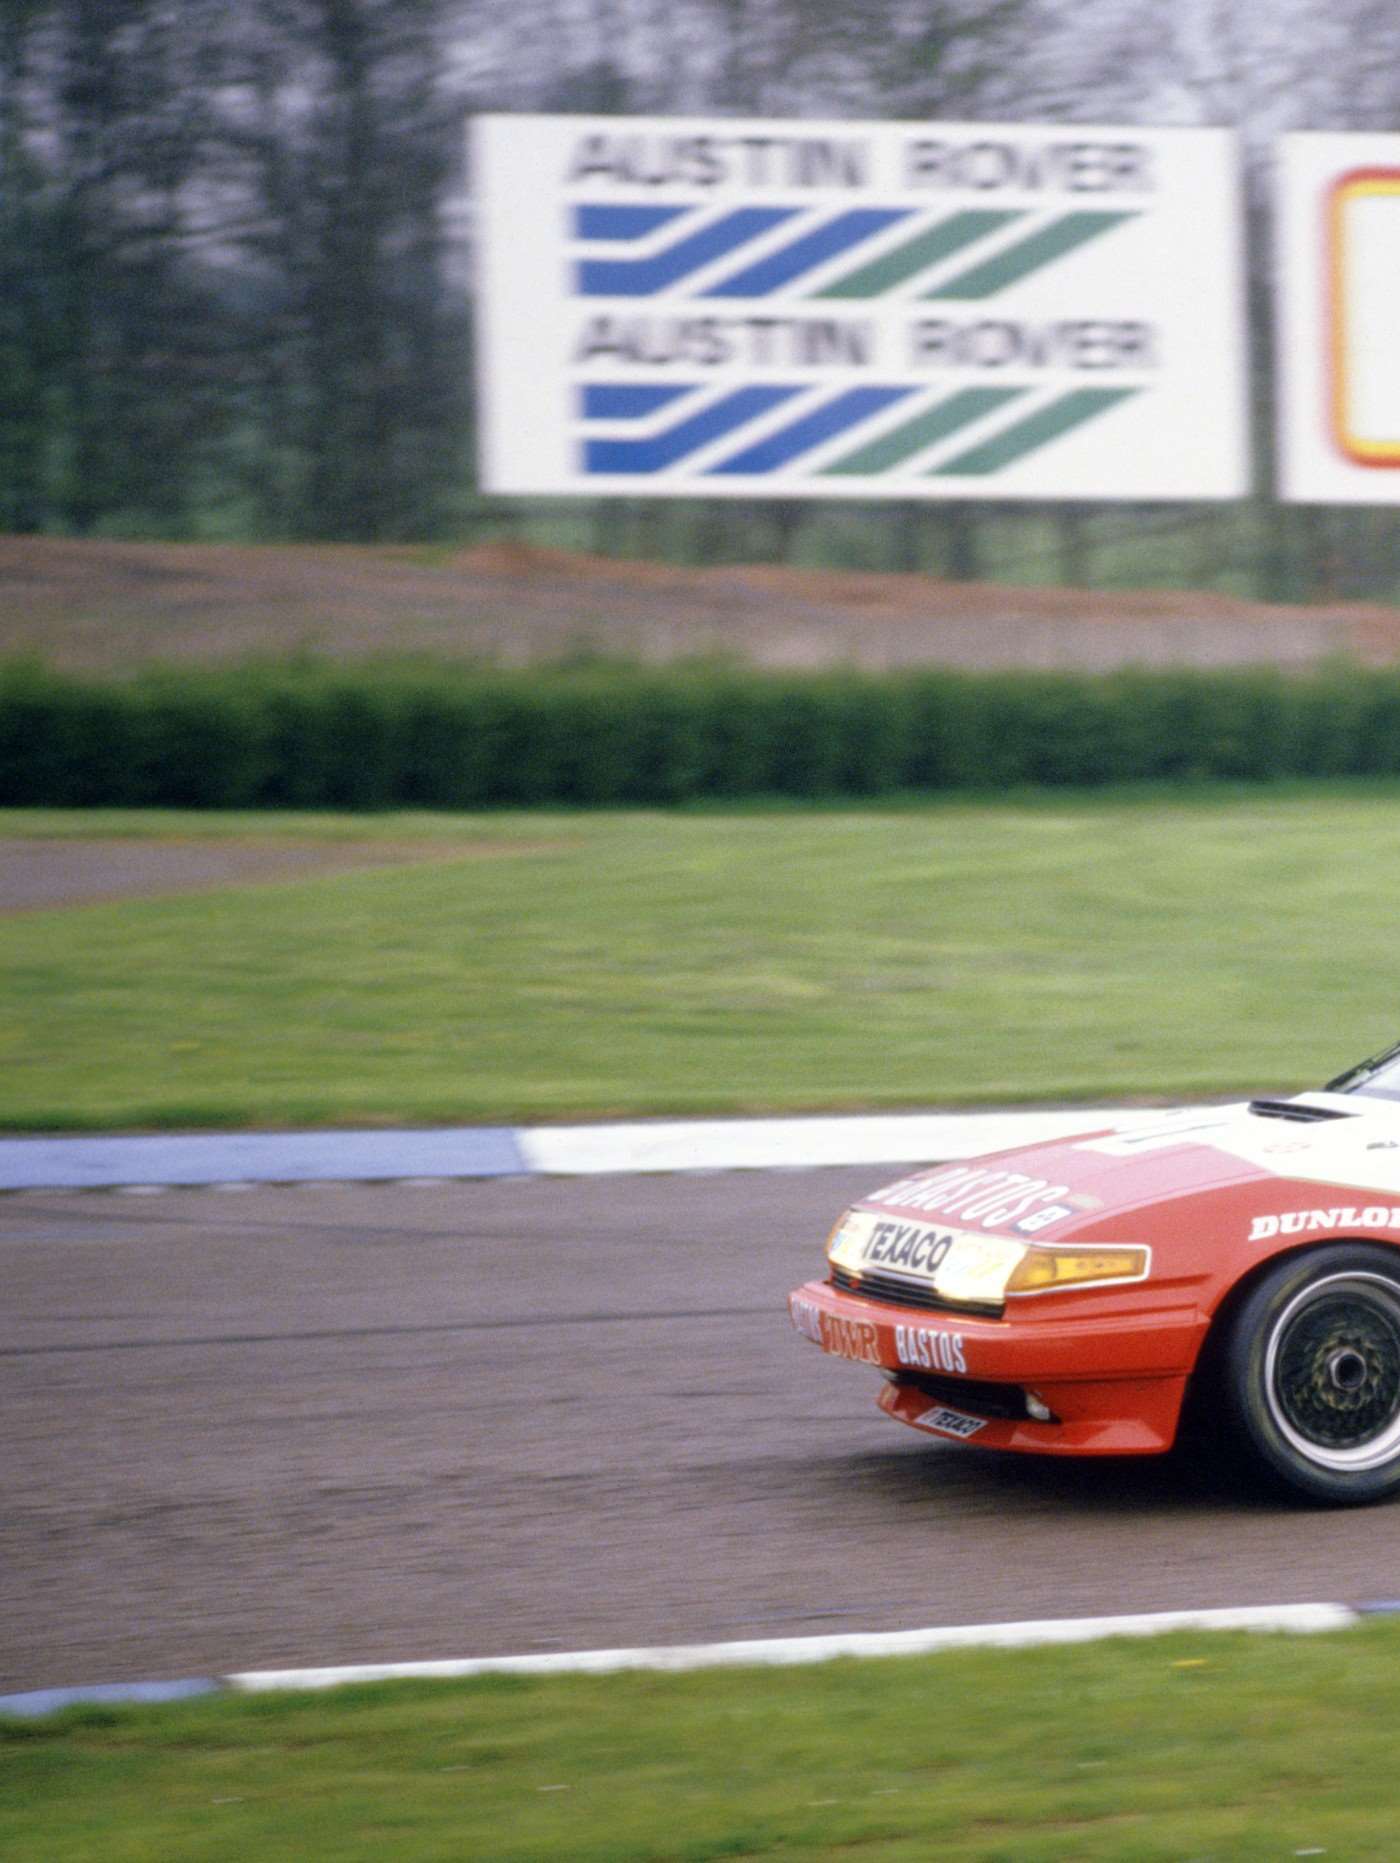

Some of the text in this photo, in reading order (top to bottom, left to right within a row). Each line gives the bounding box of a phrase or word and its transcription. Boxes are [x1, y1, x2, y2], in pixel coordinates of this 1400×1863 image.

[567, 134, 1154, 193] AUSTIN ROVER
[574, 314, 1157, 370] AUSTIN ROVER
[863, 1222, 953, 1273] TEXACO
[896, 1324, 967, 1373] BASTOS
